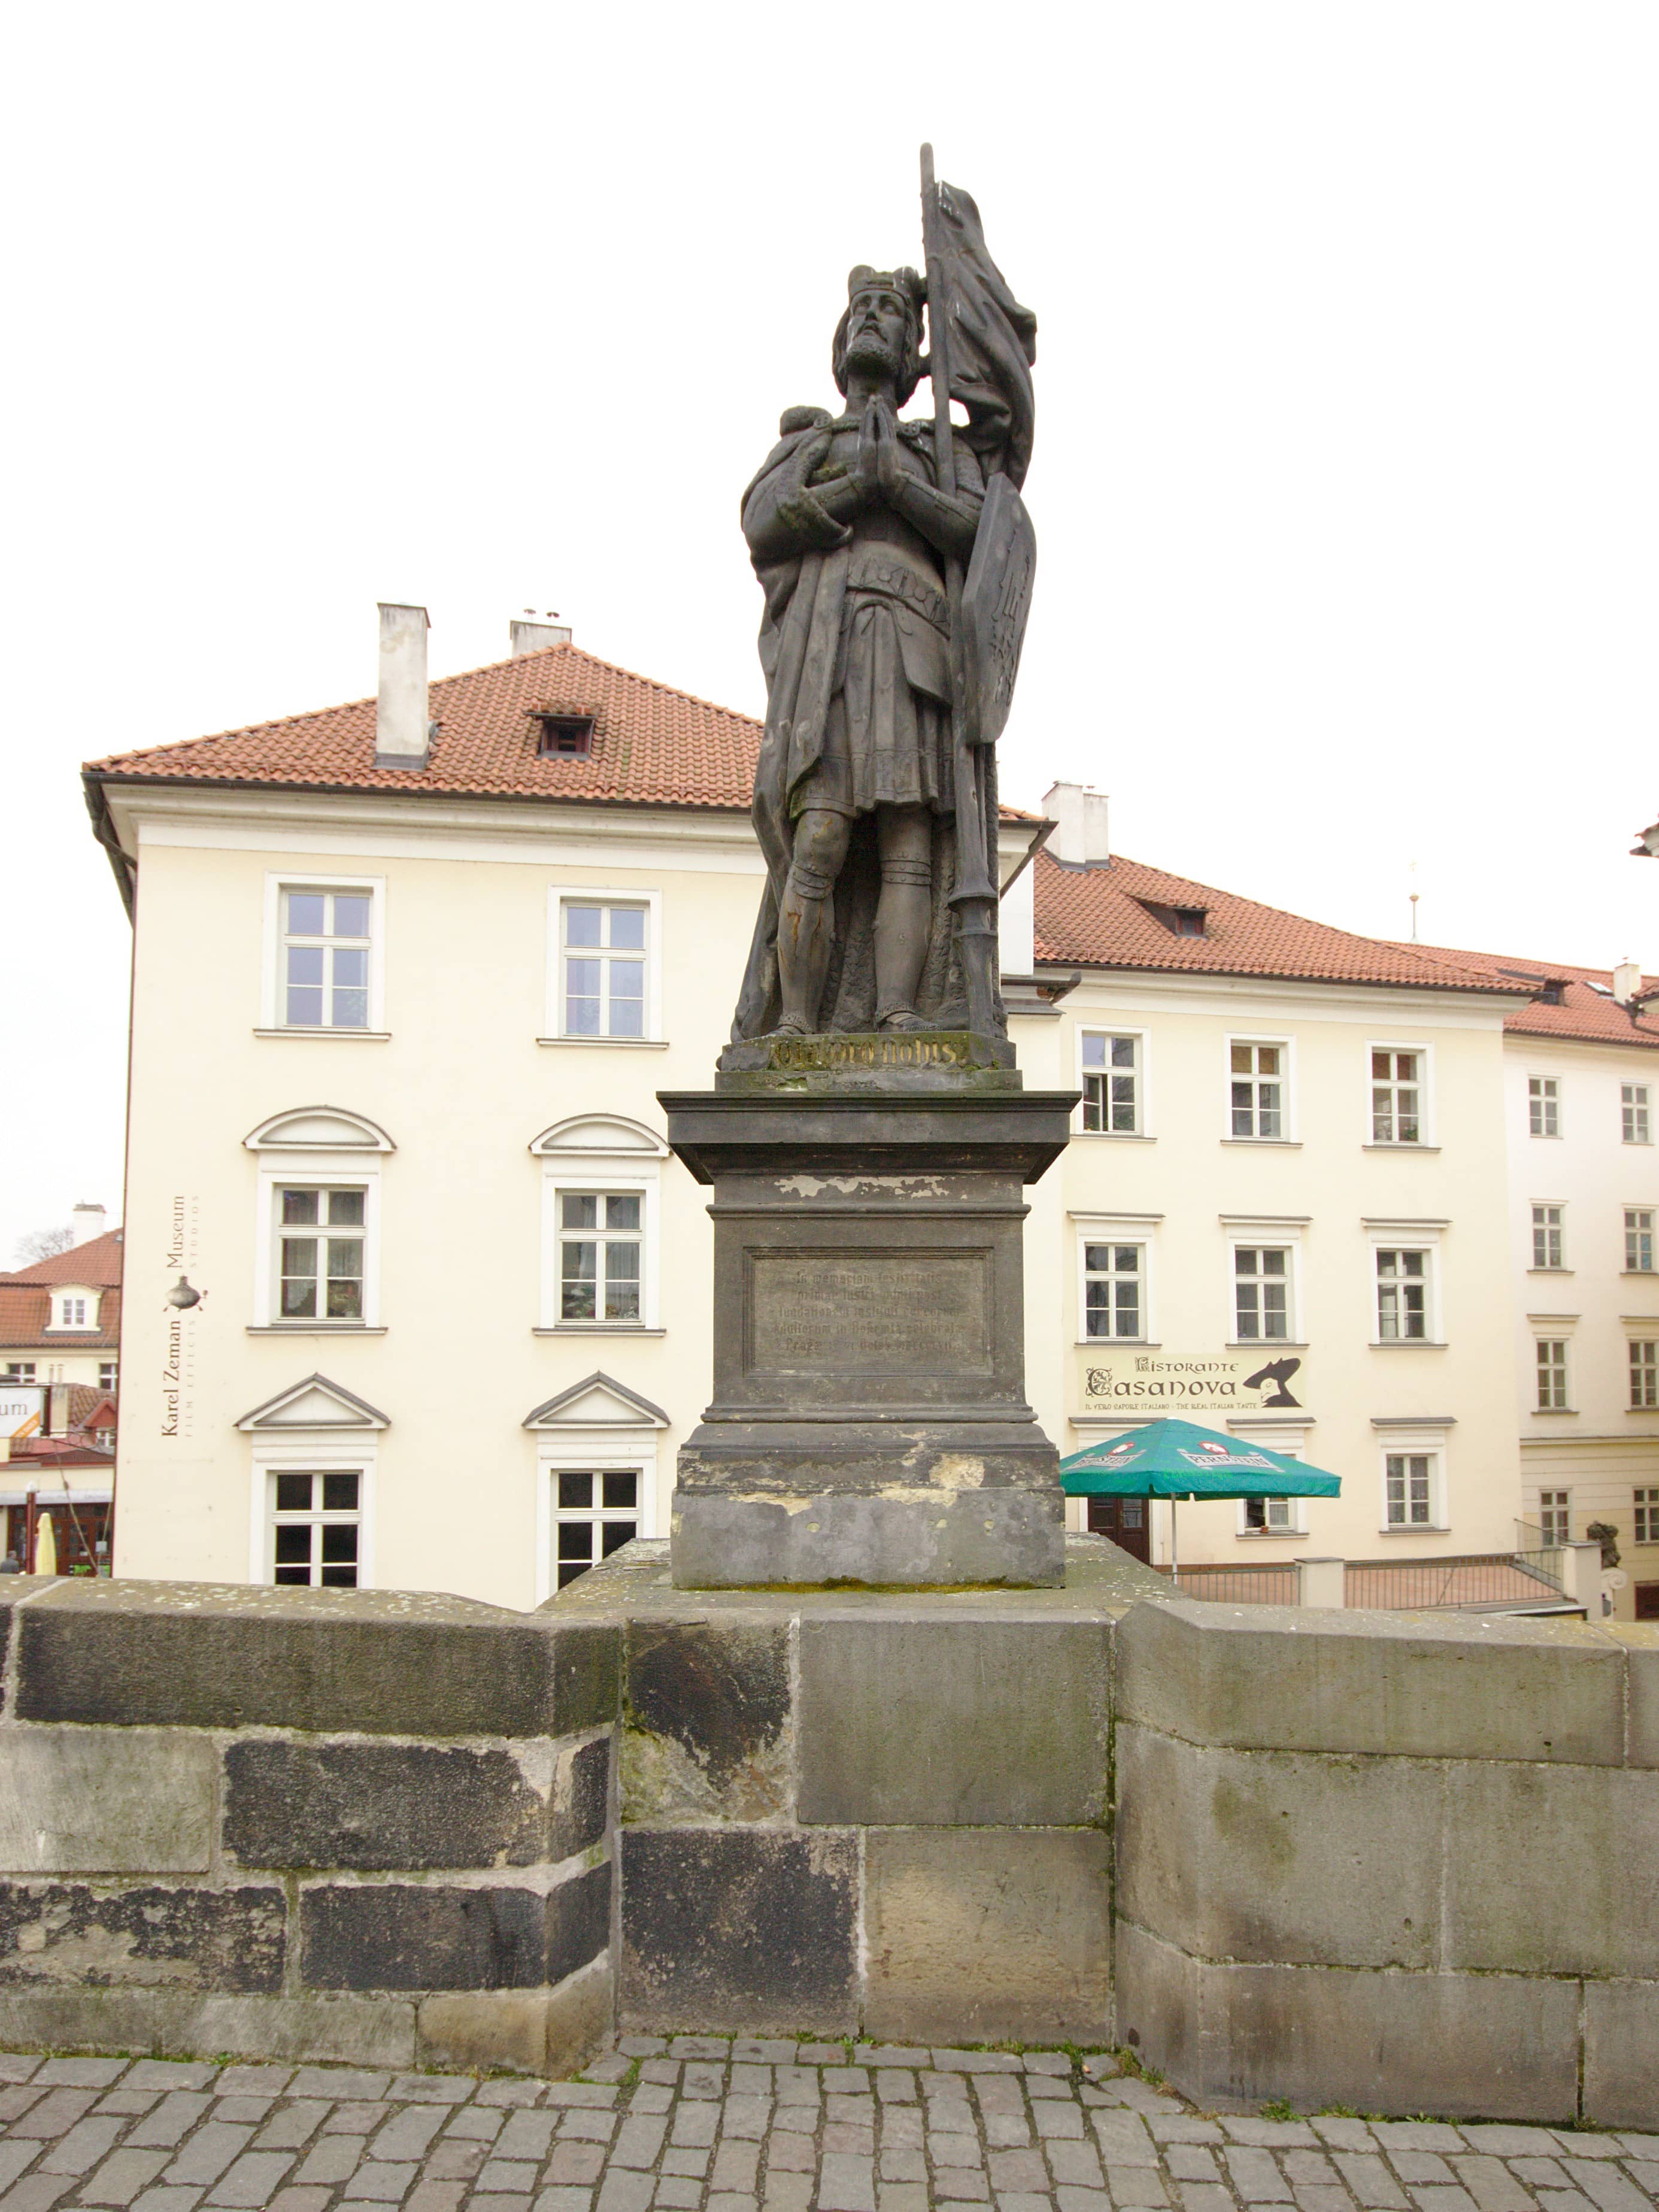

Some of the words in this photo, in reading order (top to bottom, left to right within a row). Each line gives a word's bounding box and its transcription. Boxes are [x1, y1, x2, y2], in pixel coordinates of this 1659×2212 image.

[166, 1196, 184, 1268] Museum
[163, 1320, 181, 1381] Zeman
[1135, 1356, 1239, 1374] Ristorante
[1085, 1367, 1236, 1398] Casanova
[161, 1389, 179, 1437] Karel
[1188, 1455, 1269, 1466] PERNSTEIN
